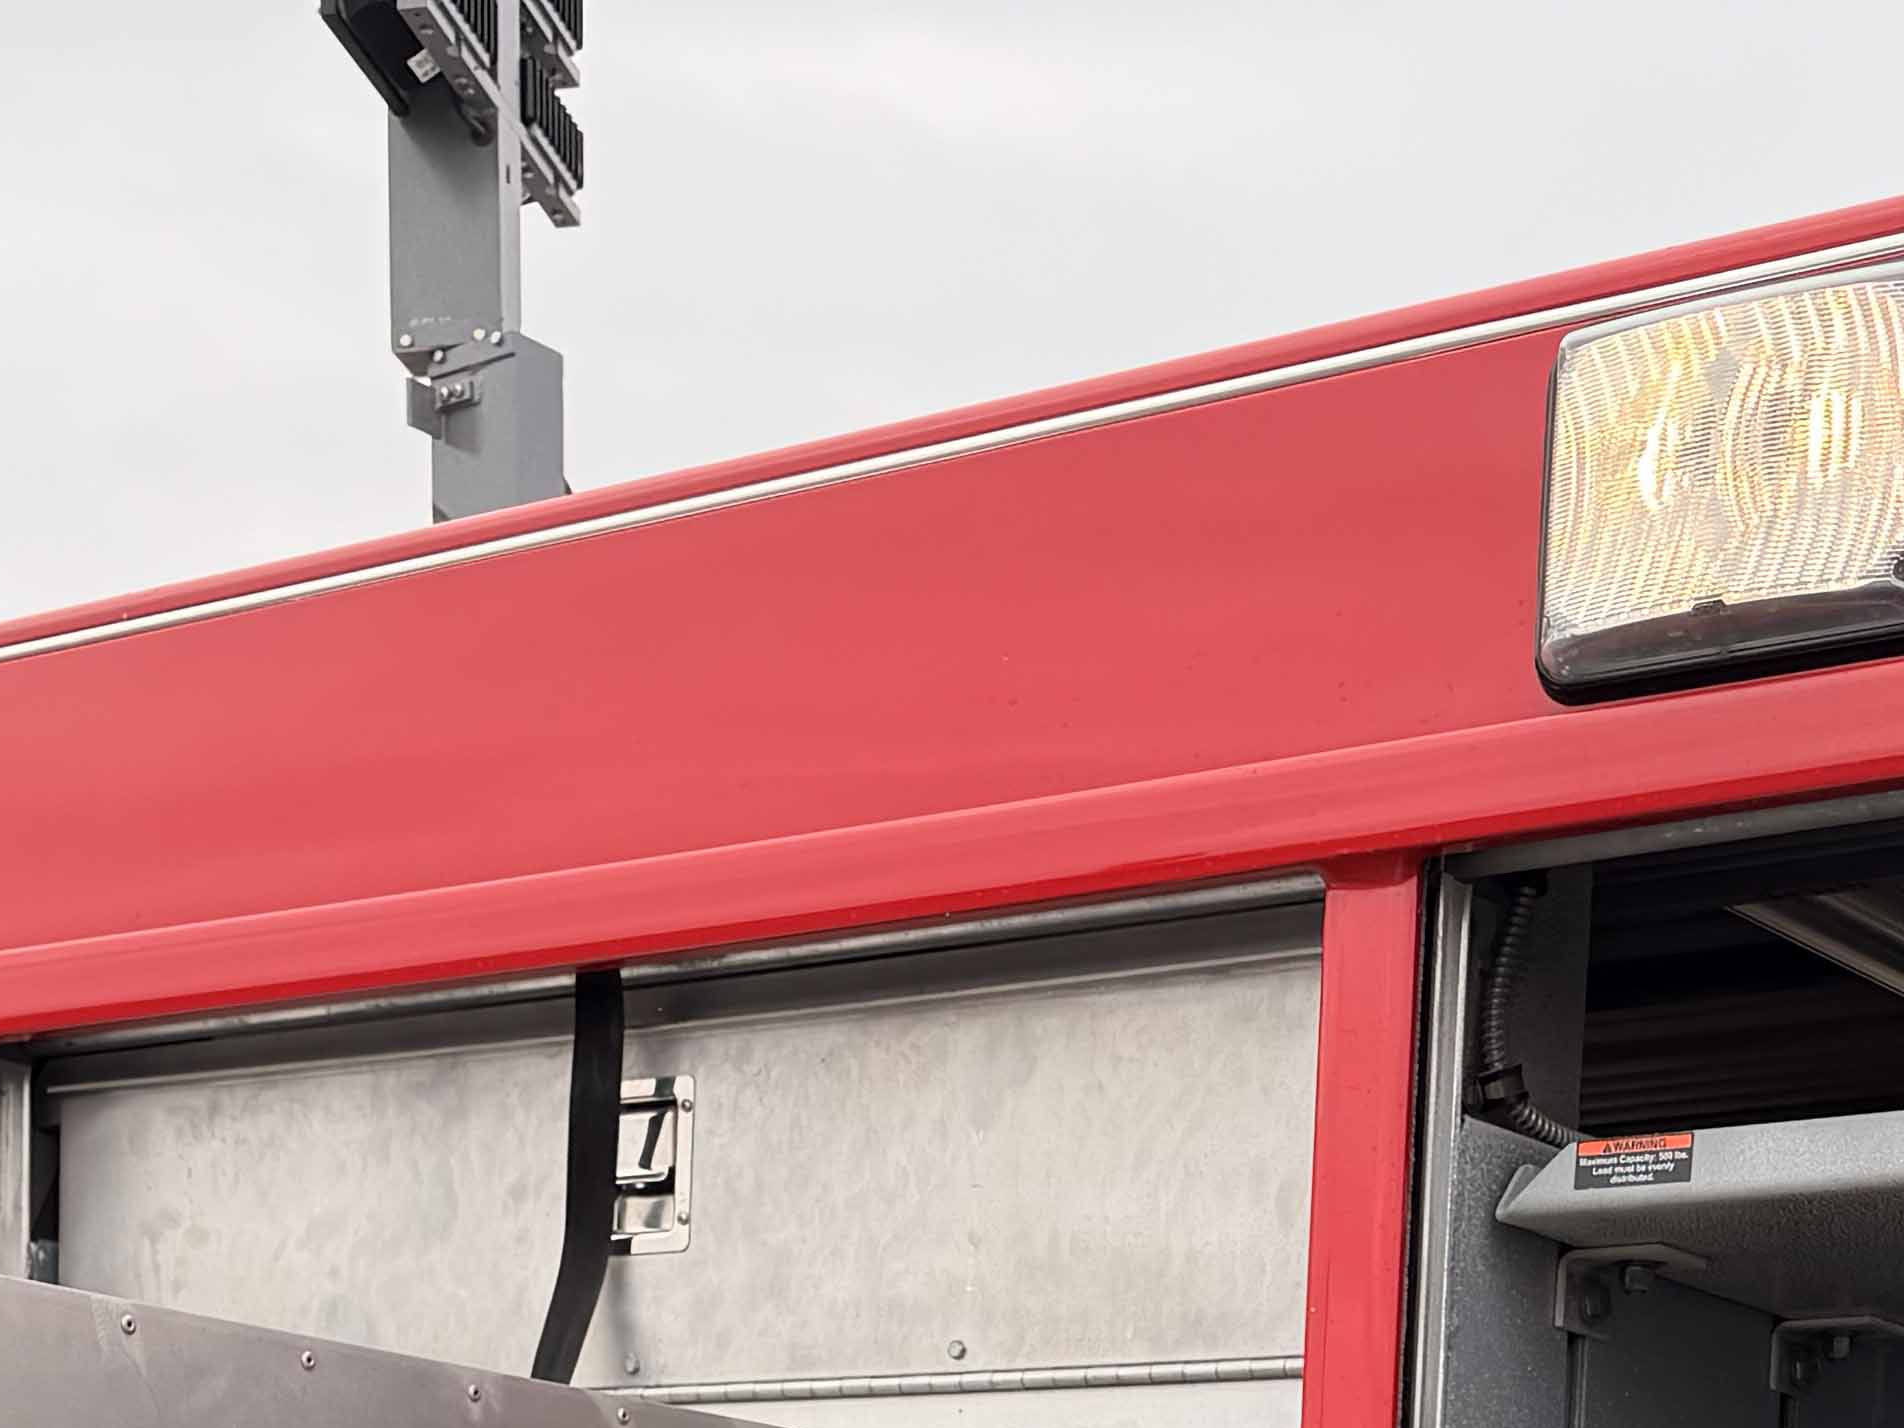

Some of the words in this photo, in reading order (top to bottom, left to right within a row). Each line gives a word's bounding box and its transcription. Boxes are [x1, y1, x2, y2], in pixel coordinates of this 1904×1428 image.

[1614, 1138, 1666, 1153] WARNING
[1579, 1156, 1617, 1166] Maximum
[1592, 1166, 1612, 1175] Load
[1615, 1165, 1634, 1173] must
[1636, 1164, 1646, 1172] be
[1648, 1161, 1675, 1172] evenly
